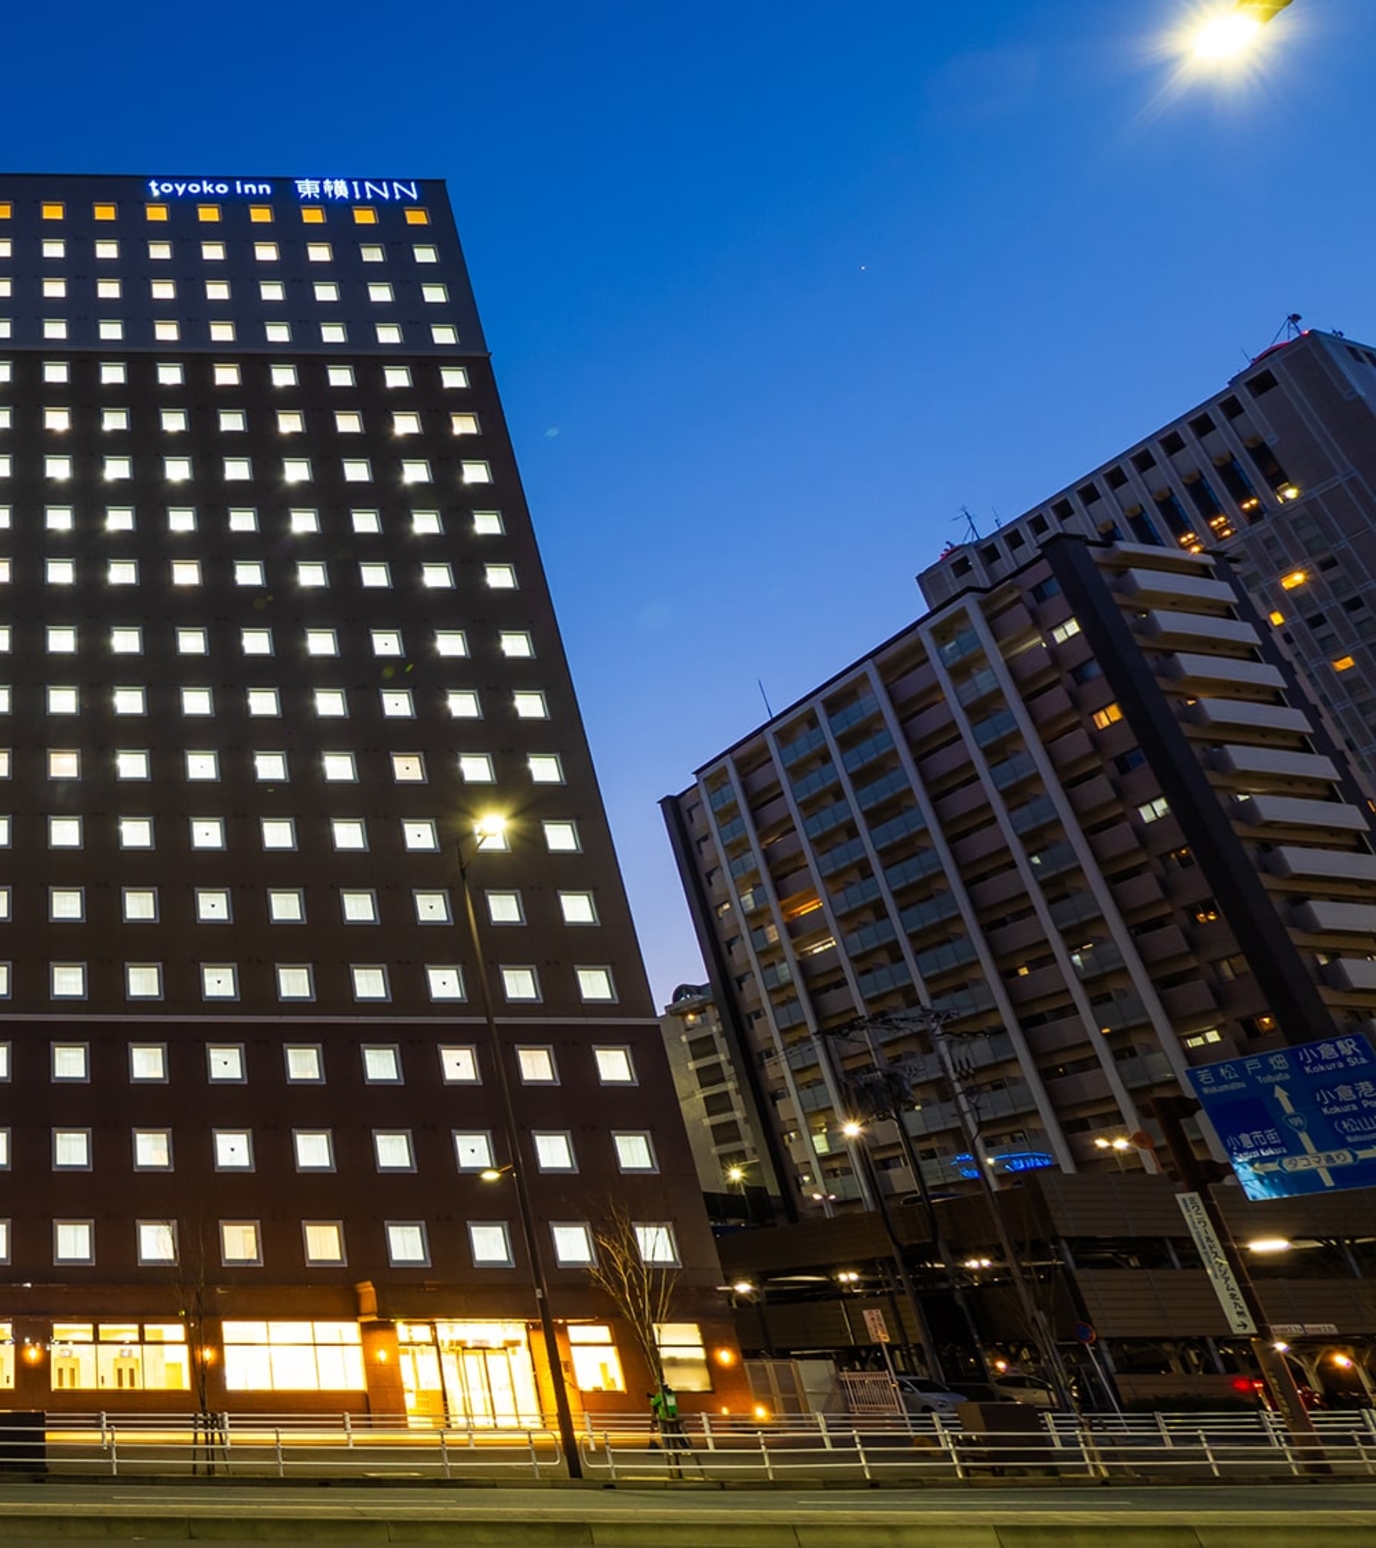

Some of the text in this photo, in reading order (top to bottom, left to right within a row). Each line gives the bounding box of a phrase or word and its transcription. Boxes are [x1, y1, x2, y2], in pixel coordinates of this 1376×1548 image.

[148, 179, 272, 197] toyoko inn
[295, 178, 419, 200] 東横INN
[1299, 1038, 1362, 1063] 小倉駅
[1197, 1054, 1289, 1085] 若松 戸畑
[1304, 1060, 1345, 1074] Kokura
[1316, 1081, 1376, 1104] 小倉港
